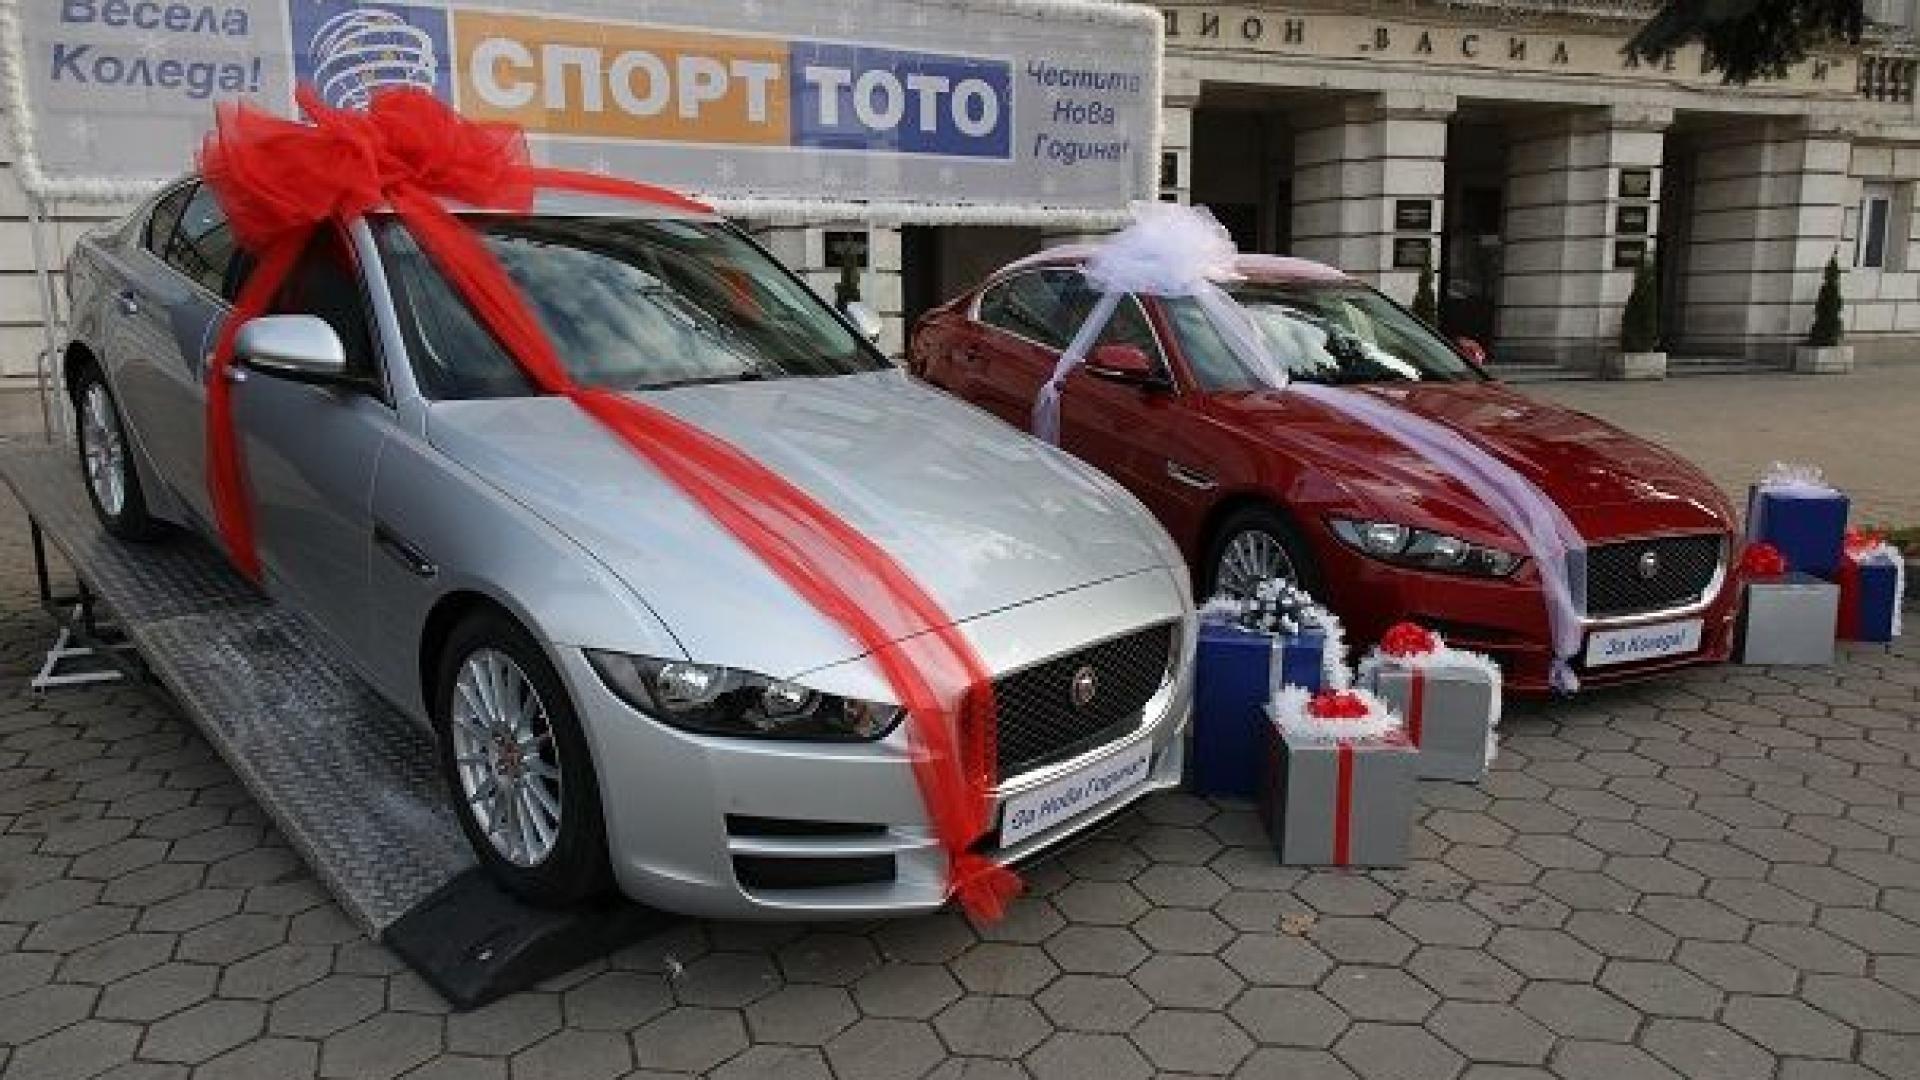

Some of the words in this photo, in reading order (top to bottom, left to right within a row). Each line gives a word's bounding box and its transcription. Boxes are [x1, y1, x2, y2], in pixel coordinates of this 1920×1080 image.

[51, 43, 260, 99] Коледа!
[470, 37, 780, 122] СПОРТ
[805, 66, 998, 137] ТОТО
[1027, 59, 1141, 93] Честита
[1053, 99, 1115, 125] Нова
